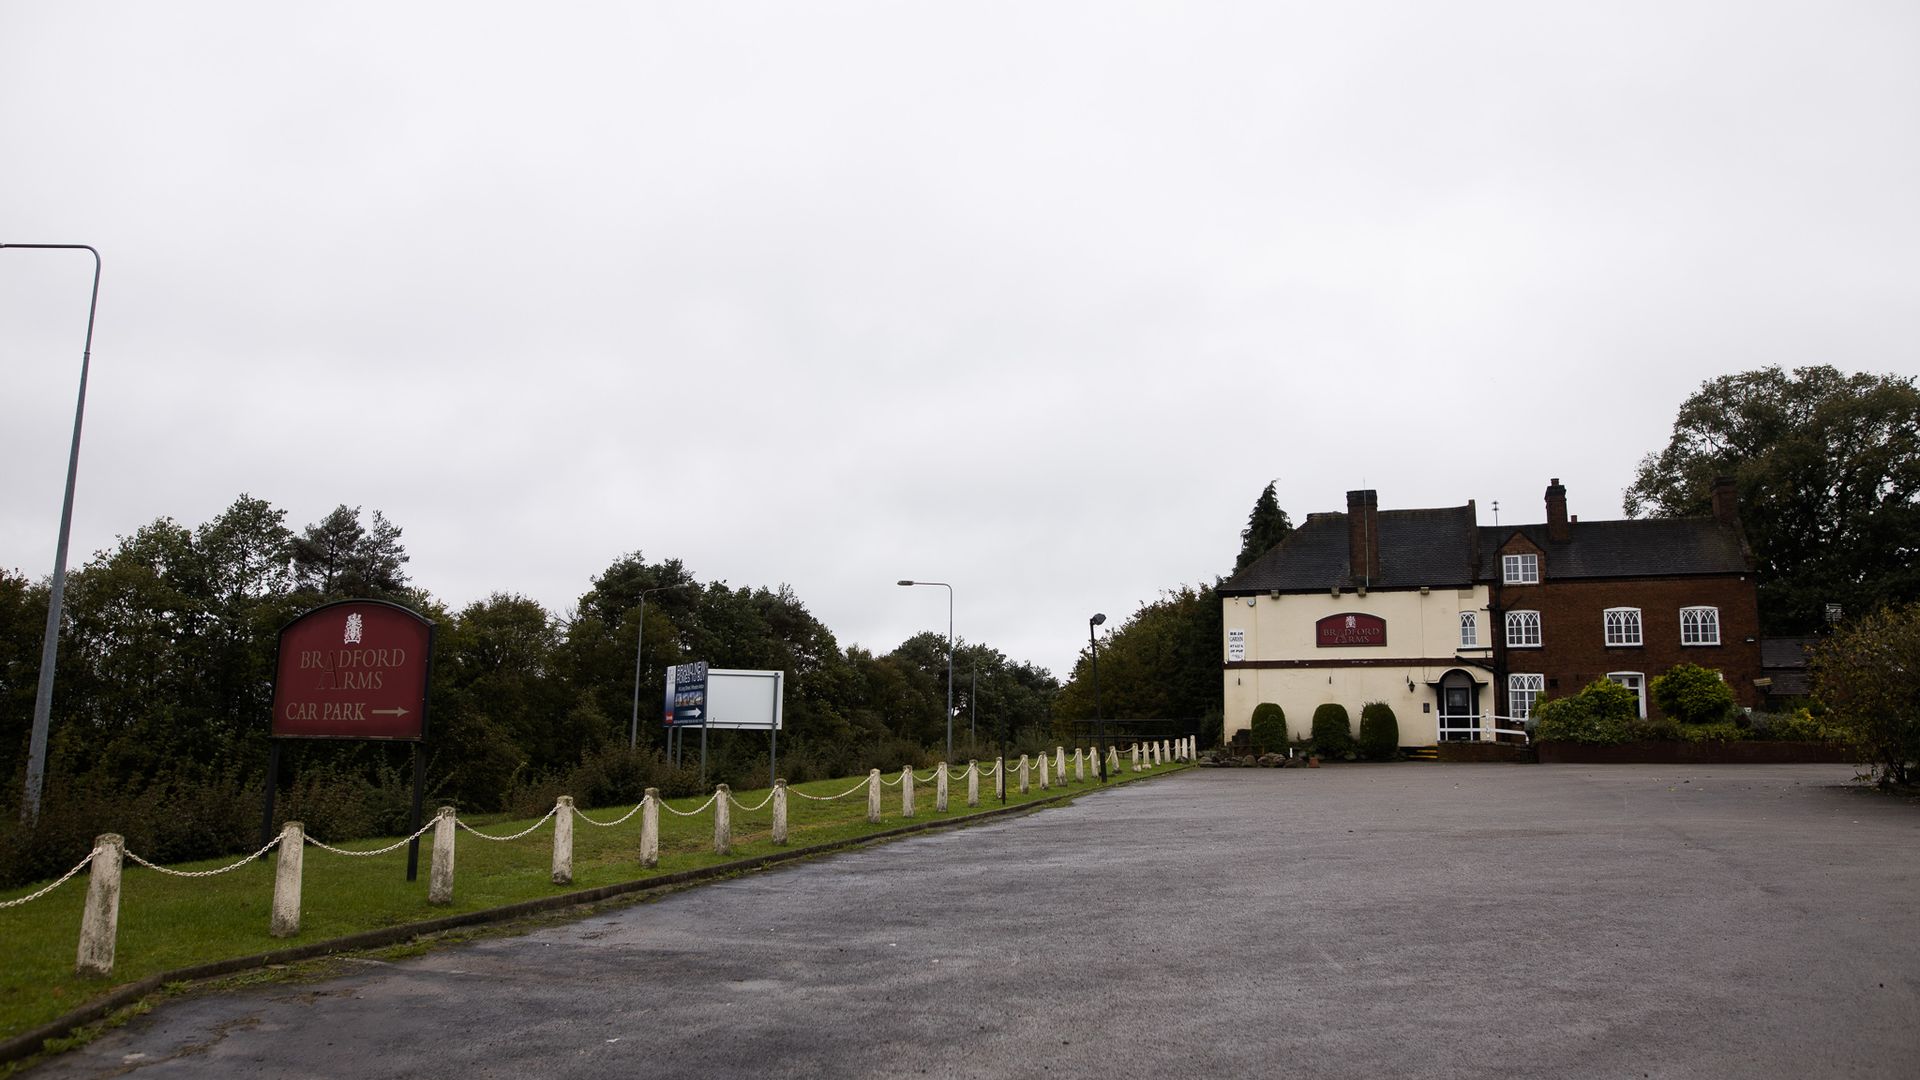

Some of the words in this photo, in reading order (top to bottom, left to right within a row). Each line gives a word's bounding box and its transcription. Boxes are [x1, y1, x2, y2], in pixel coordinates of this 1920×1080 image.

[300, 649, 405, 669] BRADFORD
[315, 671, 383, 690] ARMS
[286, 703, 317, 720] CAR
[322, 703, 366, 720] PARK
